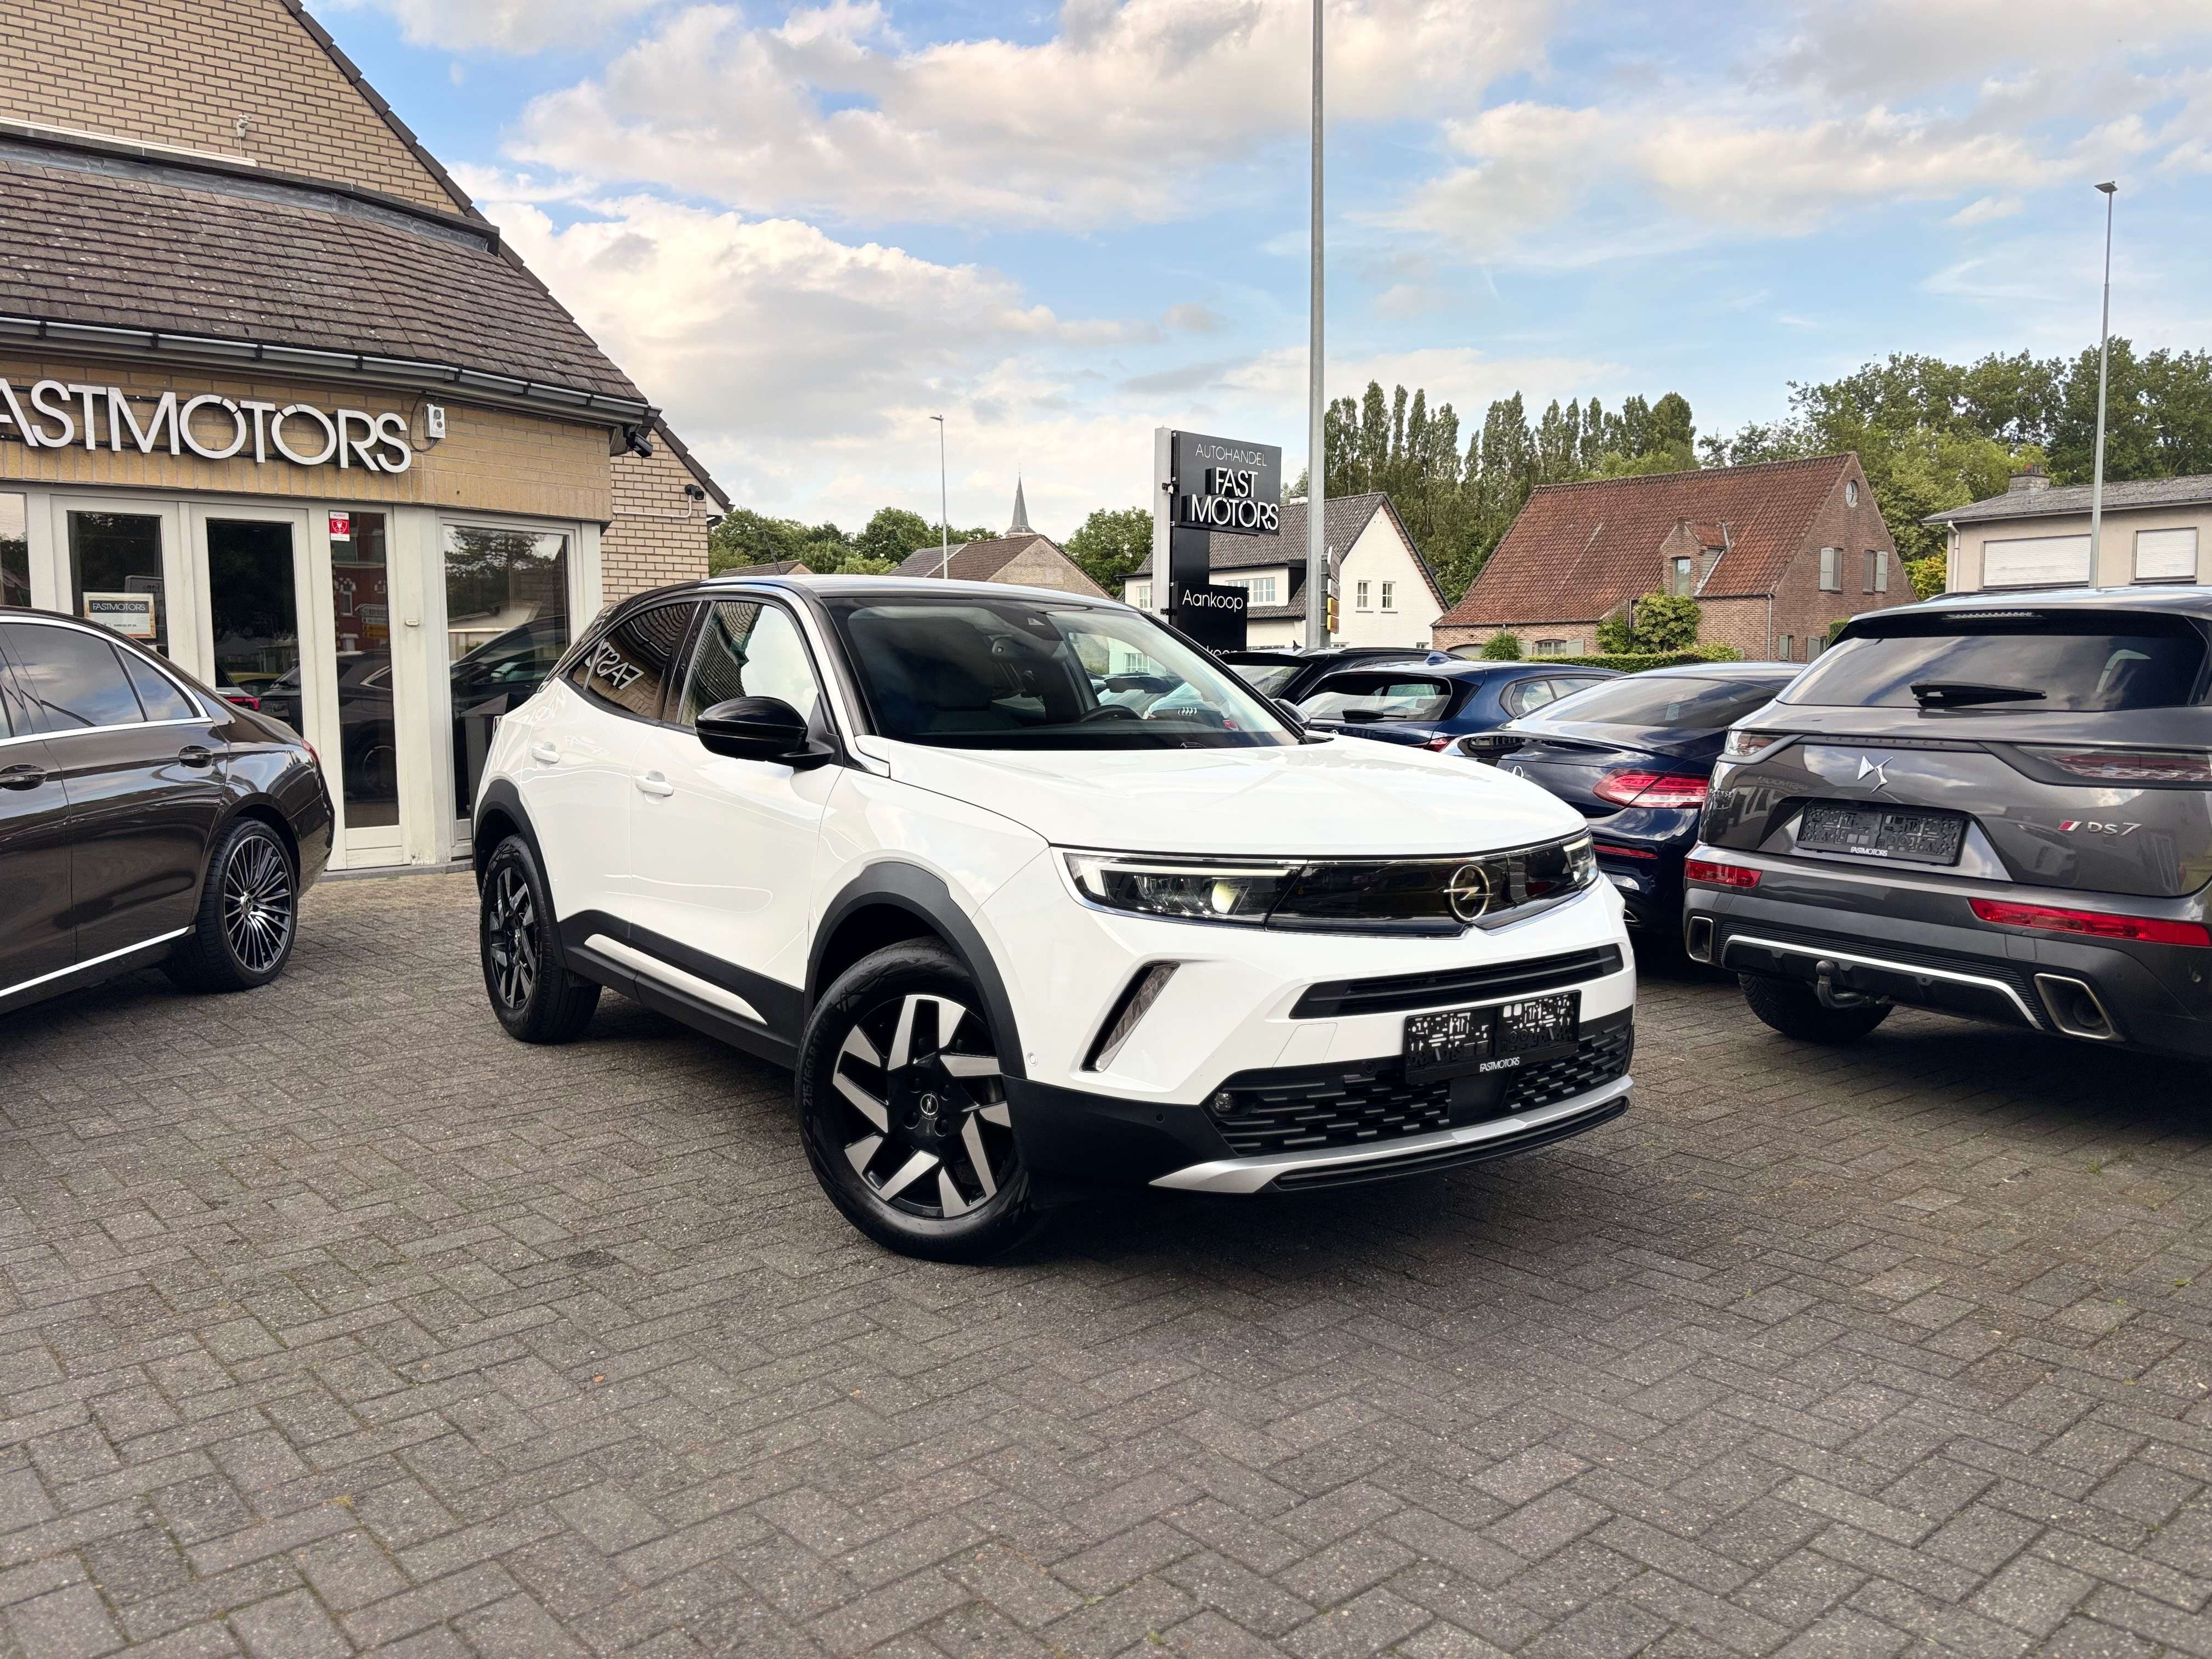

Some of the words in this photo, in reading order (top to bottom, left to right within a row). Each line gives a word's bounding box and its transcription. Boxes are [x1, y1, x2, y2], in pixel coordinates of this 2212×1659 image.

[1195, 443, 1267, 467] AUTOHANDEL
[1216, 467, 1259, 498] FAST
[1192, 494, 1279, 531] MOTORS
[92, 603, 145, 611] FASTMOTORS
[1182, 590, 1243, 612] Aankoop
[1825, 736, 1944, 746] CROSSBACK
[1850, 847, 1888, 856] FASTMOTORS
[1480, 1057, 1520, 1073] FASTMOTORS
